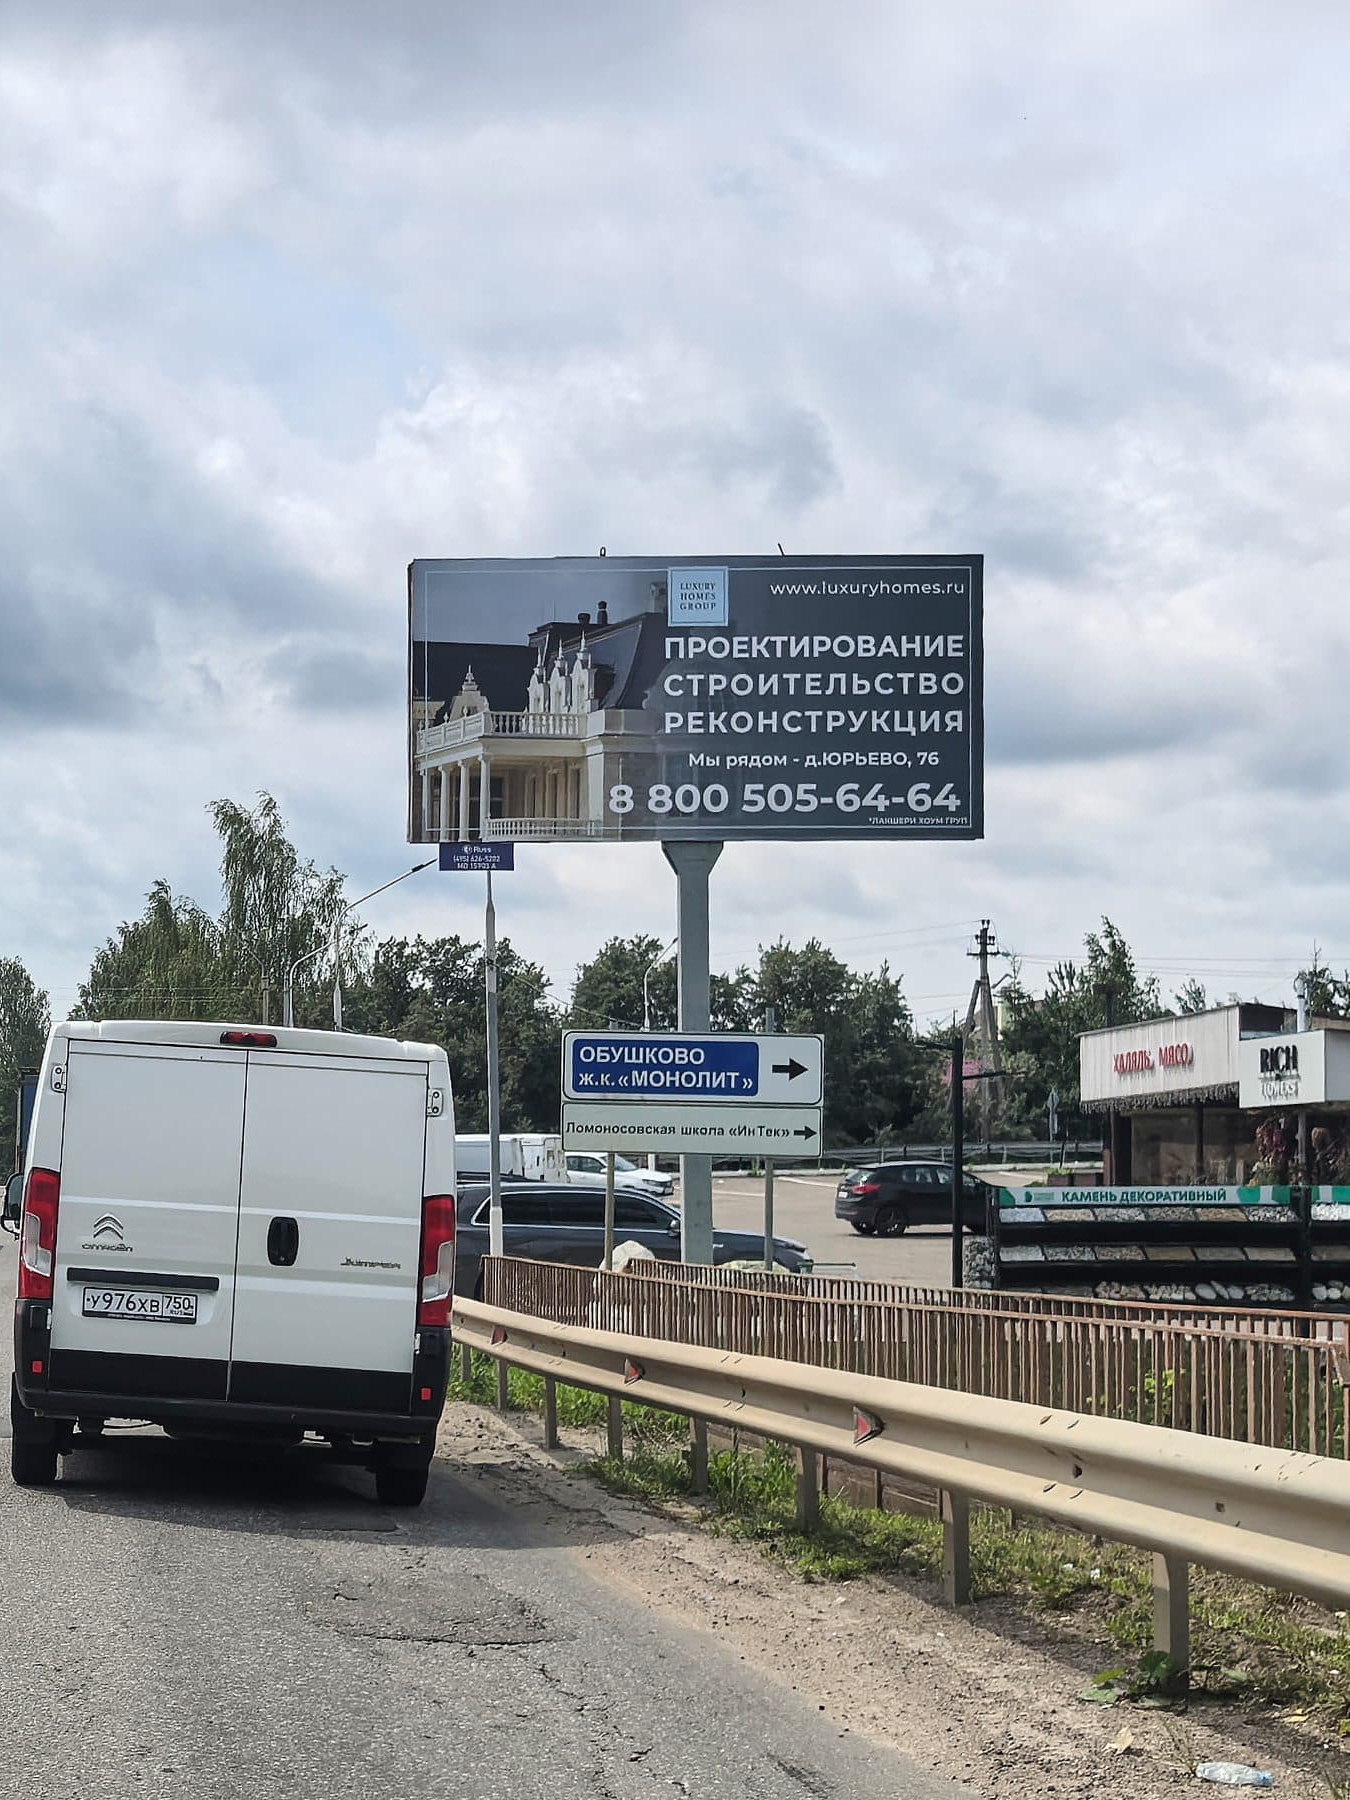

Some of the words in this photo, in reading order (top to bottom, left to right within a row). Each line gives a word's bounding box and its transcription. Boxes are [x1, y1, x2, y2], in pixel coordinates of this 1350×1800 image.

[680, 582, 716, 590] LUXURY
[769, 580, 964, 598] www.luxuryhomes.ru
[679, 602, 716, 610] GROUP
[680, 592, 716, 601] HOMES
[664, 635, 964, 659] ПРОЕКТИРОВАНИЕ
[663, 672, 965, 697] СТРОИТЕЛЬСТВО
[664, 710, 963, 737] РЕКОНСТРУКЦИЯ
[688, 753, 720, 767] Мы
[726, 755, 788, 770] рядом
[804, 751, 912, 768] д.ЮРЬЕВО,
[917, 751, 939, 766] 76
[608, 784, 634, 814] 8
[647, 784, 729, 814] 800
[742, 782, 962, 814] 505-64-64
[579, 1046, 705, 1066] ОБУШКОВО
[1157, 1041, 1195, 1068] МЯСО
[1259, 1044, 1299, 1074] RICH
[617, 1070, 754, 1090] «МОНОЛИТ»
[565, 1121, 676, 1136] Ломоносовская
[680, 1128, 725, 1137] школа
[1062, 1190, 1116, 1203] КАМЕНЬ
[1119, 1187, 1227, 1205] ДЕКОРАТИВНЫЙ
[164, 1295, 192, 1310] 750
